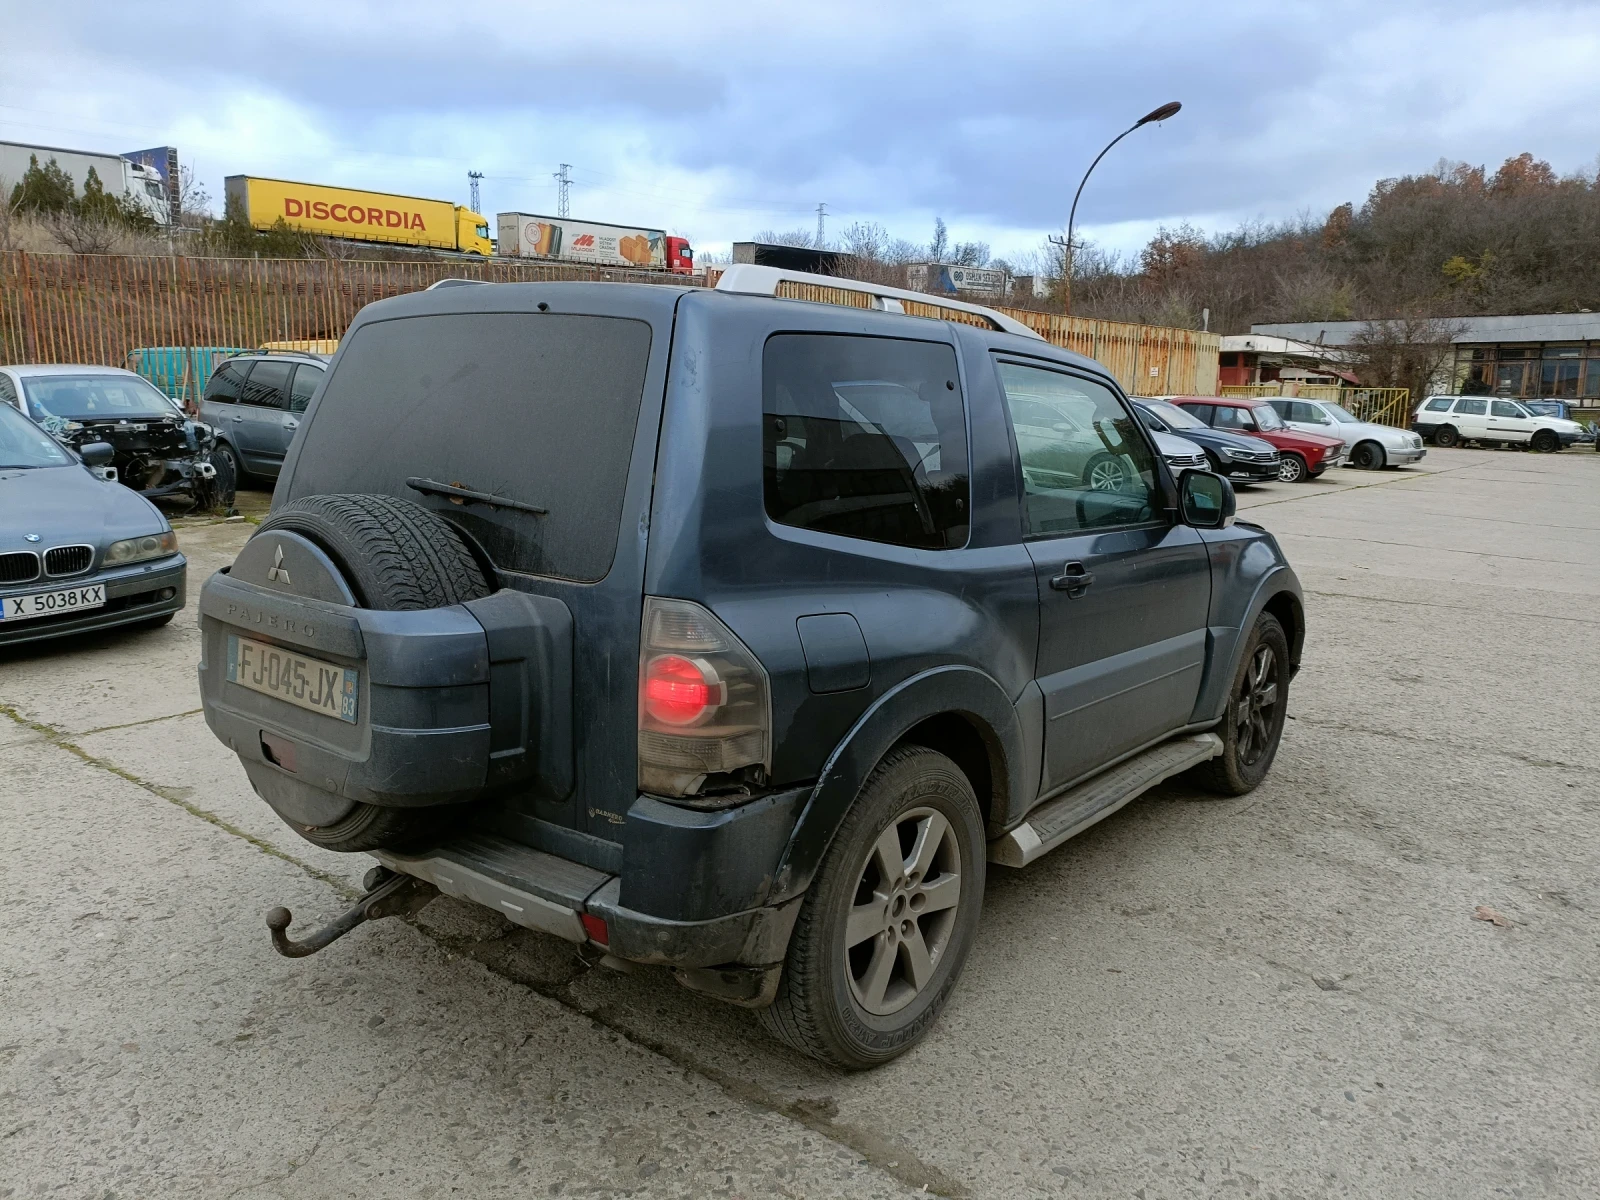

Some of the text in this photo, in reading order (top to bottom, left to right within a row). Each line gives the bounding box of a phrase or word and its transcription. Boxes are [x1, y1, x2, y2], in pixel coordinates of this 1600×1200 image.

[284, 198, 426, 231] DISCORDIA
[13, 587, 102, 614] X 5038 KX
[227, 604, 315, 637] PAJERO
[342, 696, 355, 717] 83
[880, 993, 943, 1048] DUNLOP
